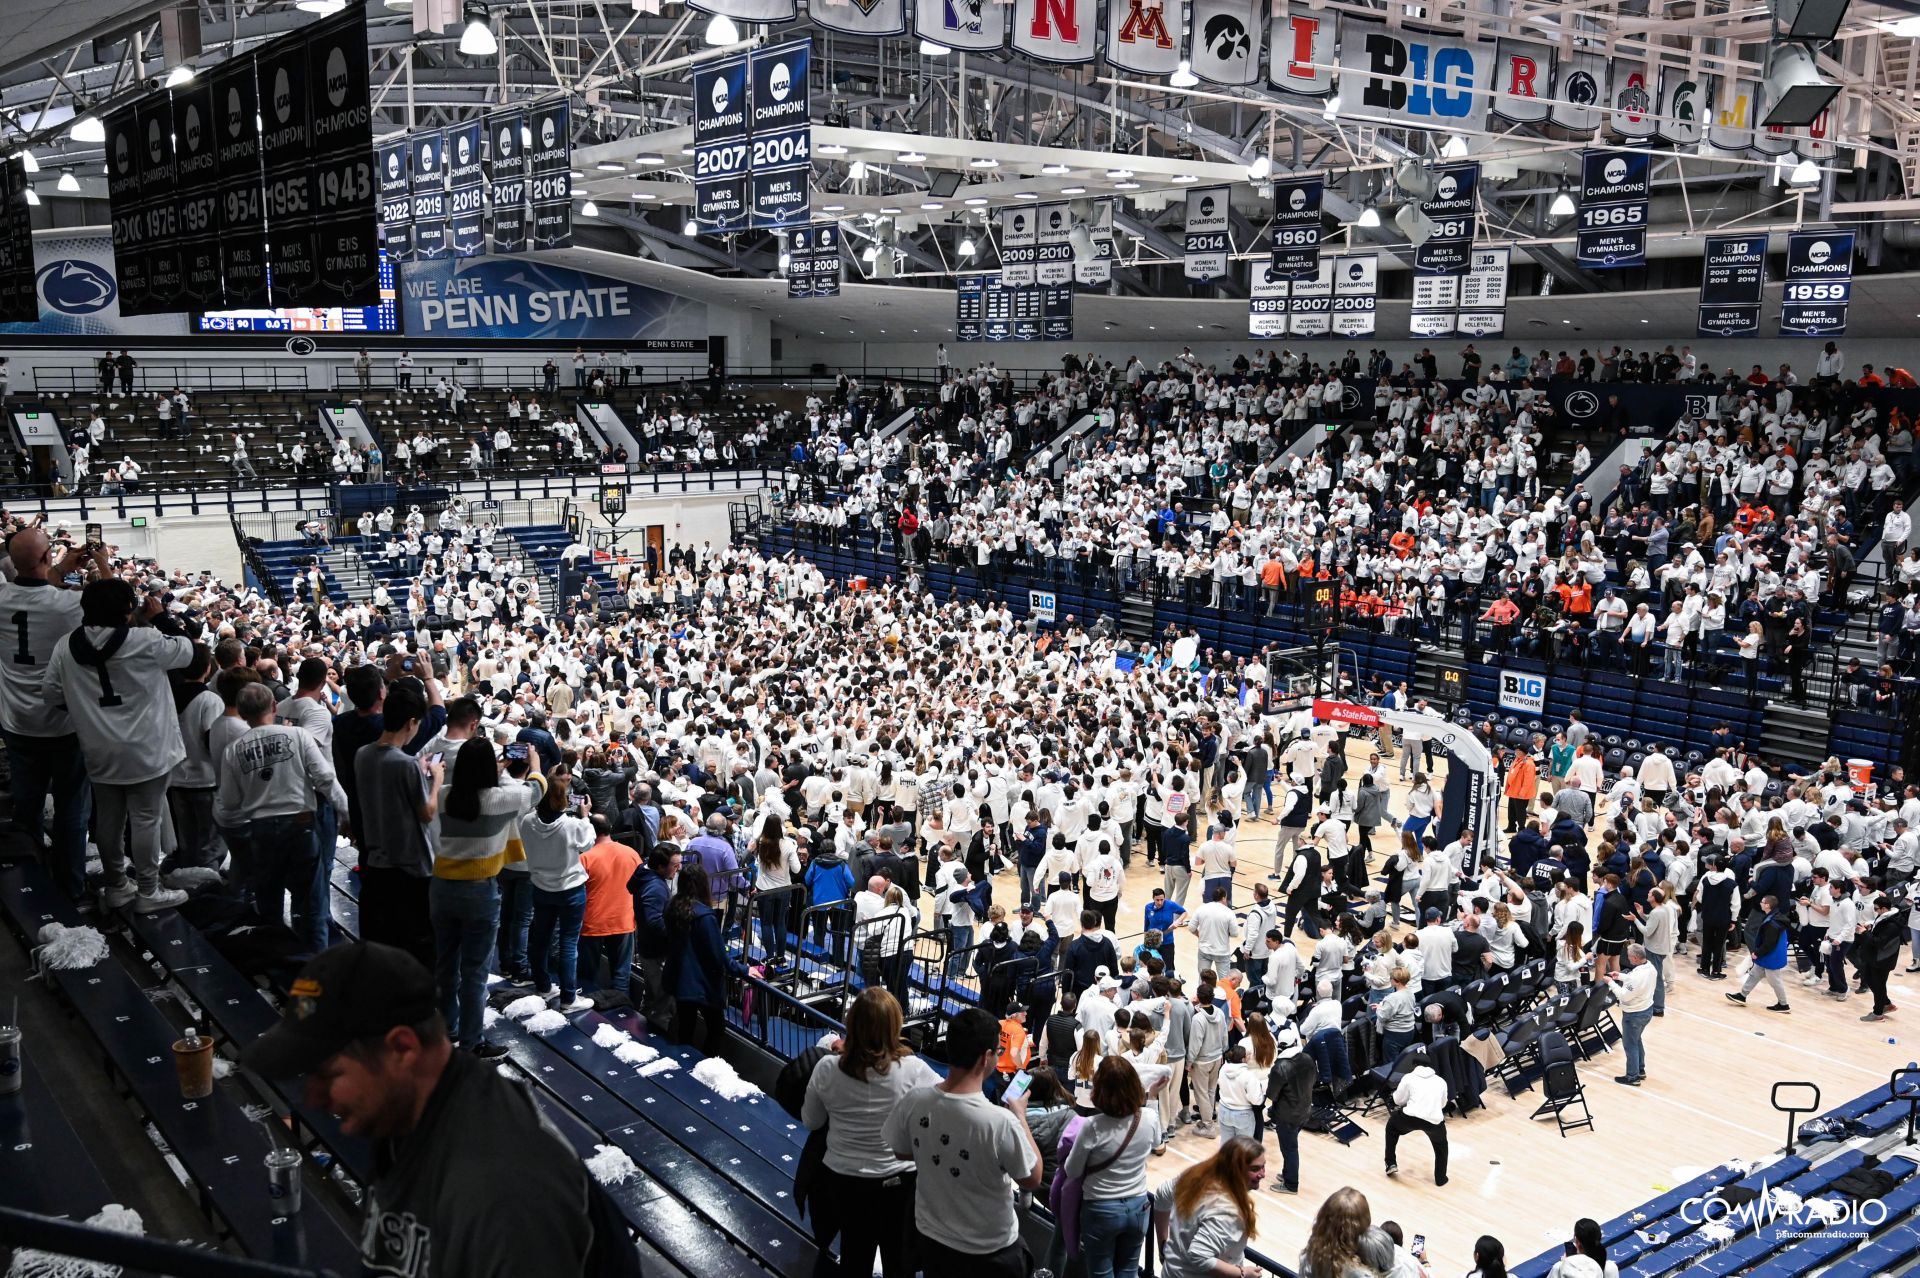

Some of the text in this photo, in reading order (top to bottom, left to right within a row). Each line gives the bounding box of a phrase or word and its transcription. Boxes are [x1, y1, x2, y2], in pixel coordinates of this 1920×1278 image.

[1508, 54, 1538, 99] R
[756, 99, 805, 121] CHAMPIONS
[699, 112, 743, 132] CHAMPIONS
[753, 135, 809, 166] 2004
[697, 145, 747, 175] 2007
[534, 177, 567, 199] 2016
[769, 180, 790, 193] MEN'S
[1586, 182, 1645, 196] CHAMPIONS
[494, 183, 523, 204] 2017
[712, 189, 732, 201] MEN'S
[760, 192, 803, 207] GYMNASTICS
[416, 197, 443, 215] 2019
[453, 189, 481, 212] 2018
[702, 199, 740, 214] GYMNASTICS
[1423, 199, 1471, 210] CHAMPIONS
[384, 203, 410, 221] 2022
[1277, 210, 1318, 220] CHAMPIONS
[1583, 206, 1643, 227] 1965
[1189, 216, 1225, 226] CHAMPIONS
[1432, 221, 1466, 237] 961
[1187, 236, 1224, 250] 2014
[1275, 230, 1317, 246] 1960
[1599, 237, 1624, 245] MEN'S
[1039, 246, 1070, 260] 2010
[1433, 248, 1454, 256] MEN'S
[1587, 244, 1637, 253] GYMNASTICS
[1811, 250, 1830, 259] NCAA
[1002, 249, 1036, 262] 2009
[1286, 254, 1304, 262] MEN'S
[1422, 254, 1462, 263] GYMNASTICS
[1709, 255, 1761, 264] CHAMPIONS
[790, 261, 811, 273] 1994
[814, 259, 839, 271] 2008
[1190, 264, 1220, 272] VOLLEYBALL
[1277, 260, 1314, 269] GYMNASTICS
[1791, 264, 1847, 273] CHAMPIONS
[405, 277, 483, 298] WE ARE
[1253, 284, 1286, 292] CHAMPIONS
[1295, 282, 1330, 290] CHAMPIONS
[1338, 281, 1375, 289] CHAMPIONS
[1788, 284, 1845, 300] 1959
[420, 286, 631, 331] PENN STATE
[1252, 300, 1286, 312] 1999
[1292, 298, 1330, 311] 2007
[1335, 297, 1375, 310] 2008
[1789, 316, 1837, 325] GYMNASTICS
[1801, 310, 1826, 318] MEN'S
[1707, 318, 1750, 326] GYMNASTICS
[647, 339, 696, 349] PENN STATE
[12, 611, 36, 665] 1
[1502, 694, 1542, 708] NETWORK
[263, 741, 282, 757] ARE
[1849, 768, 1859, 780] G
[1471, 773, 1481, 799] STATE
[1468, 801, 1479, 830] PENN
